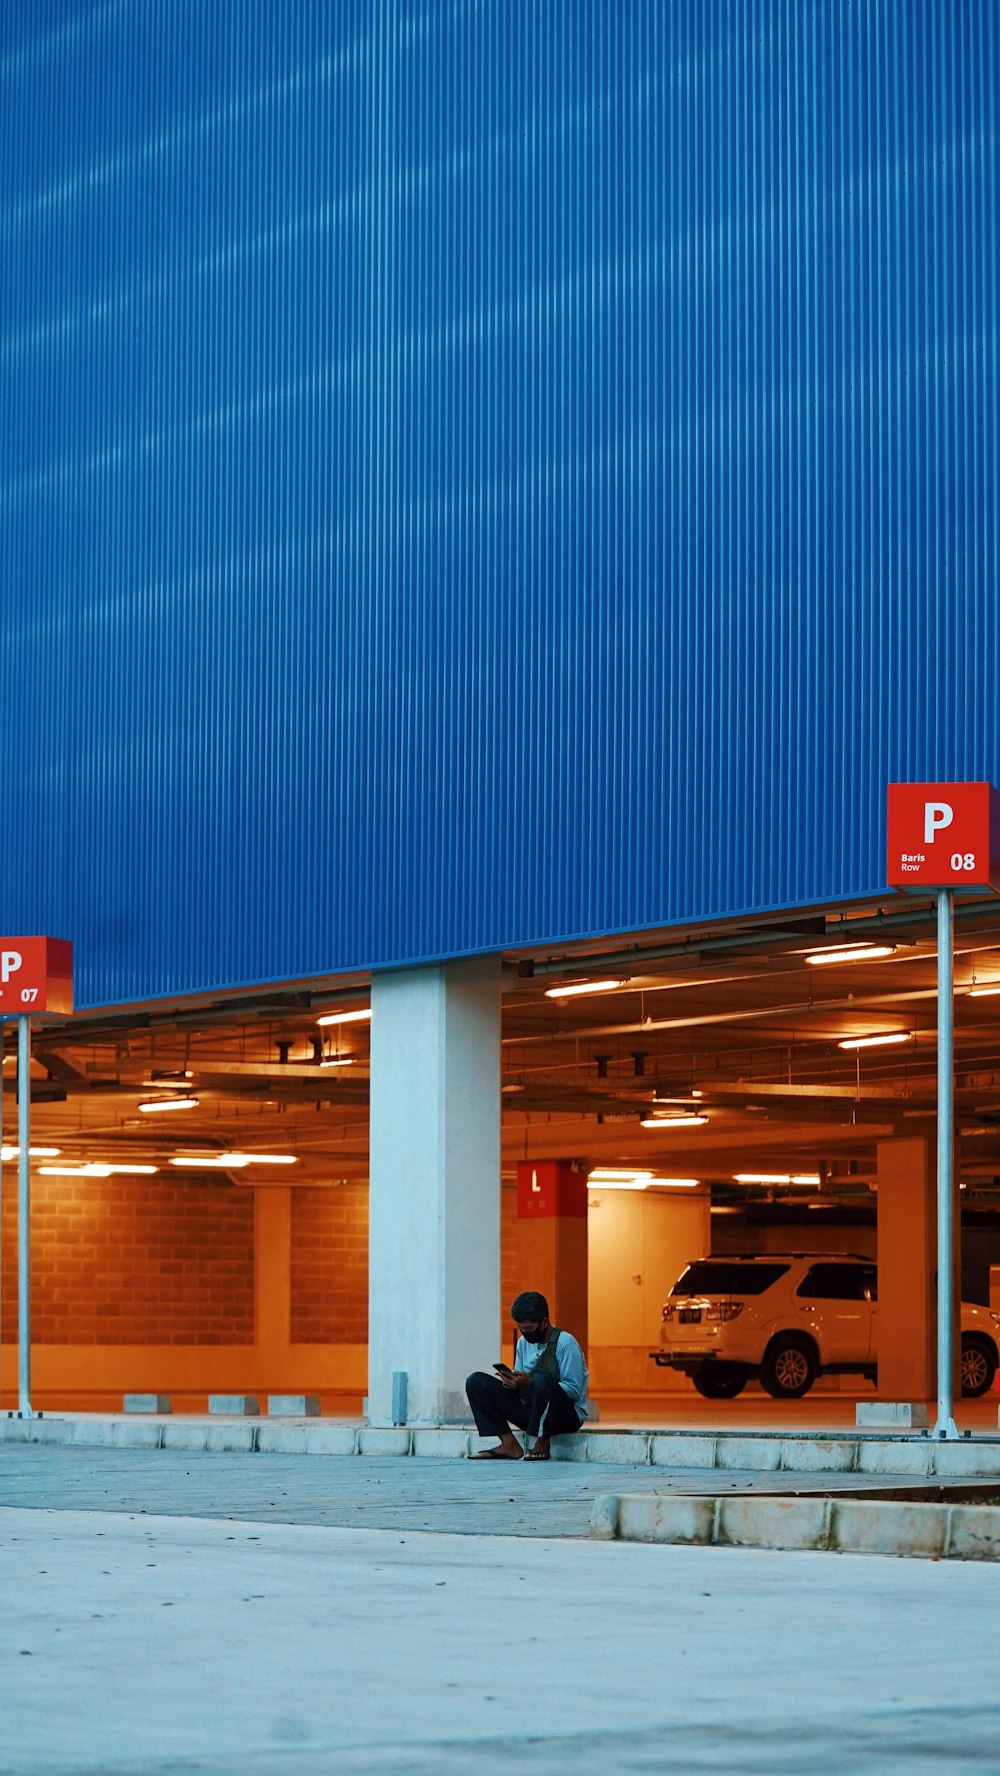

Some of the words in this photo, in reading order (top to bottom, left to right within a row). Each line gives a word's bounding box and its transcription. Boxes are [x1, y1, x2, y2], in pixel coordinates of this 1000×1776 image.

[924, 802, 953, 843] P
[901, 854, 925, 862] Baris
[950, 853, 975, 870] 08
[901, 863, 920, 871] Row
[1, 951, 22, 982] P
[21, 988, 38, 1002] 07
[532, 1169, 541, 1192] L
